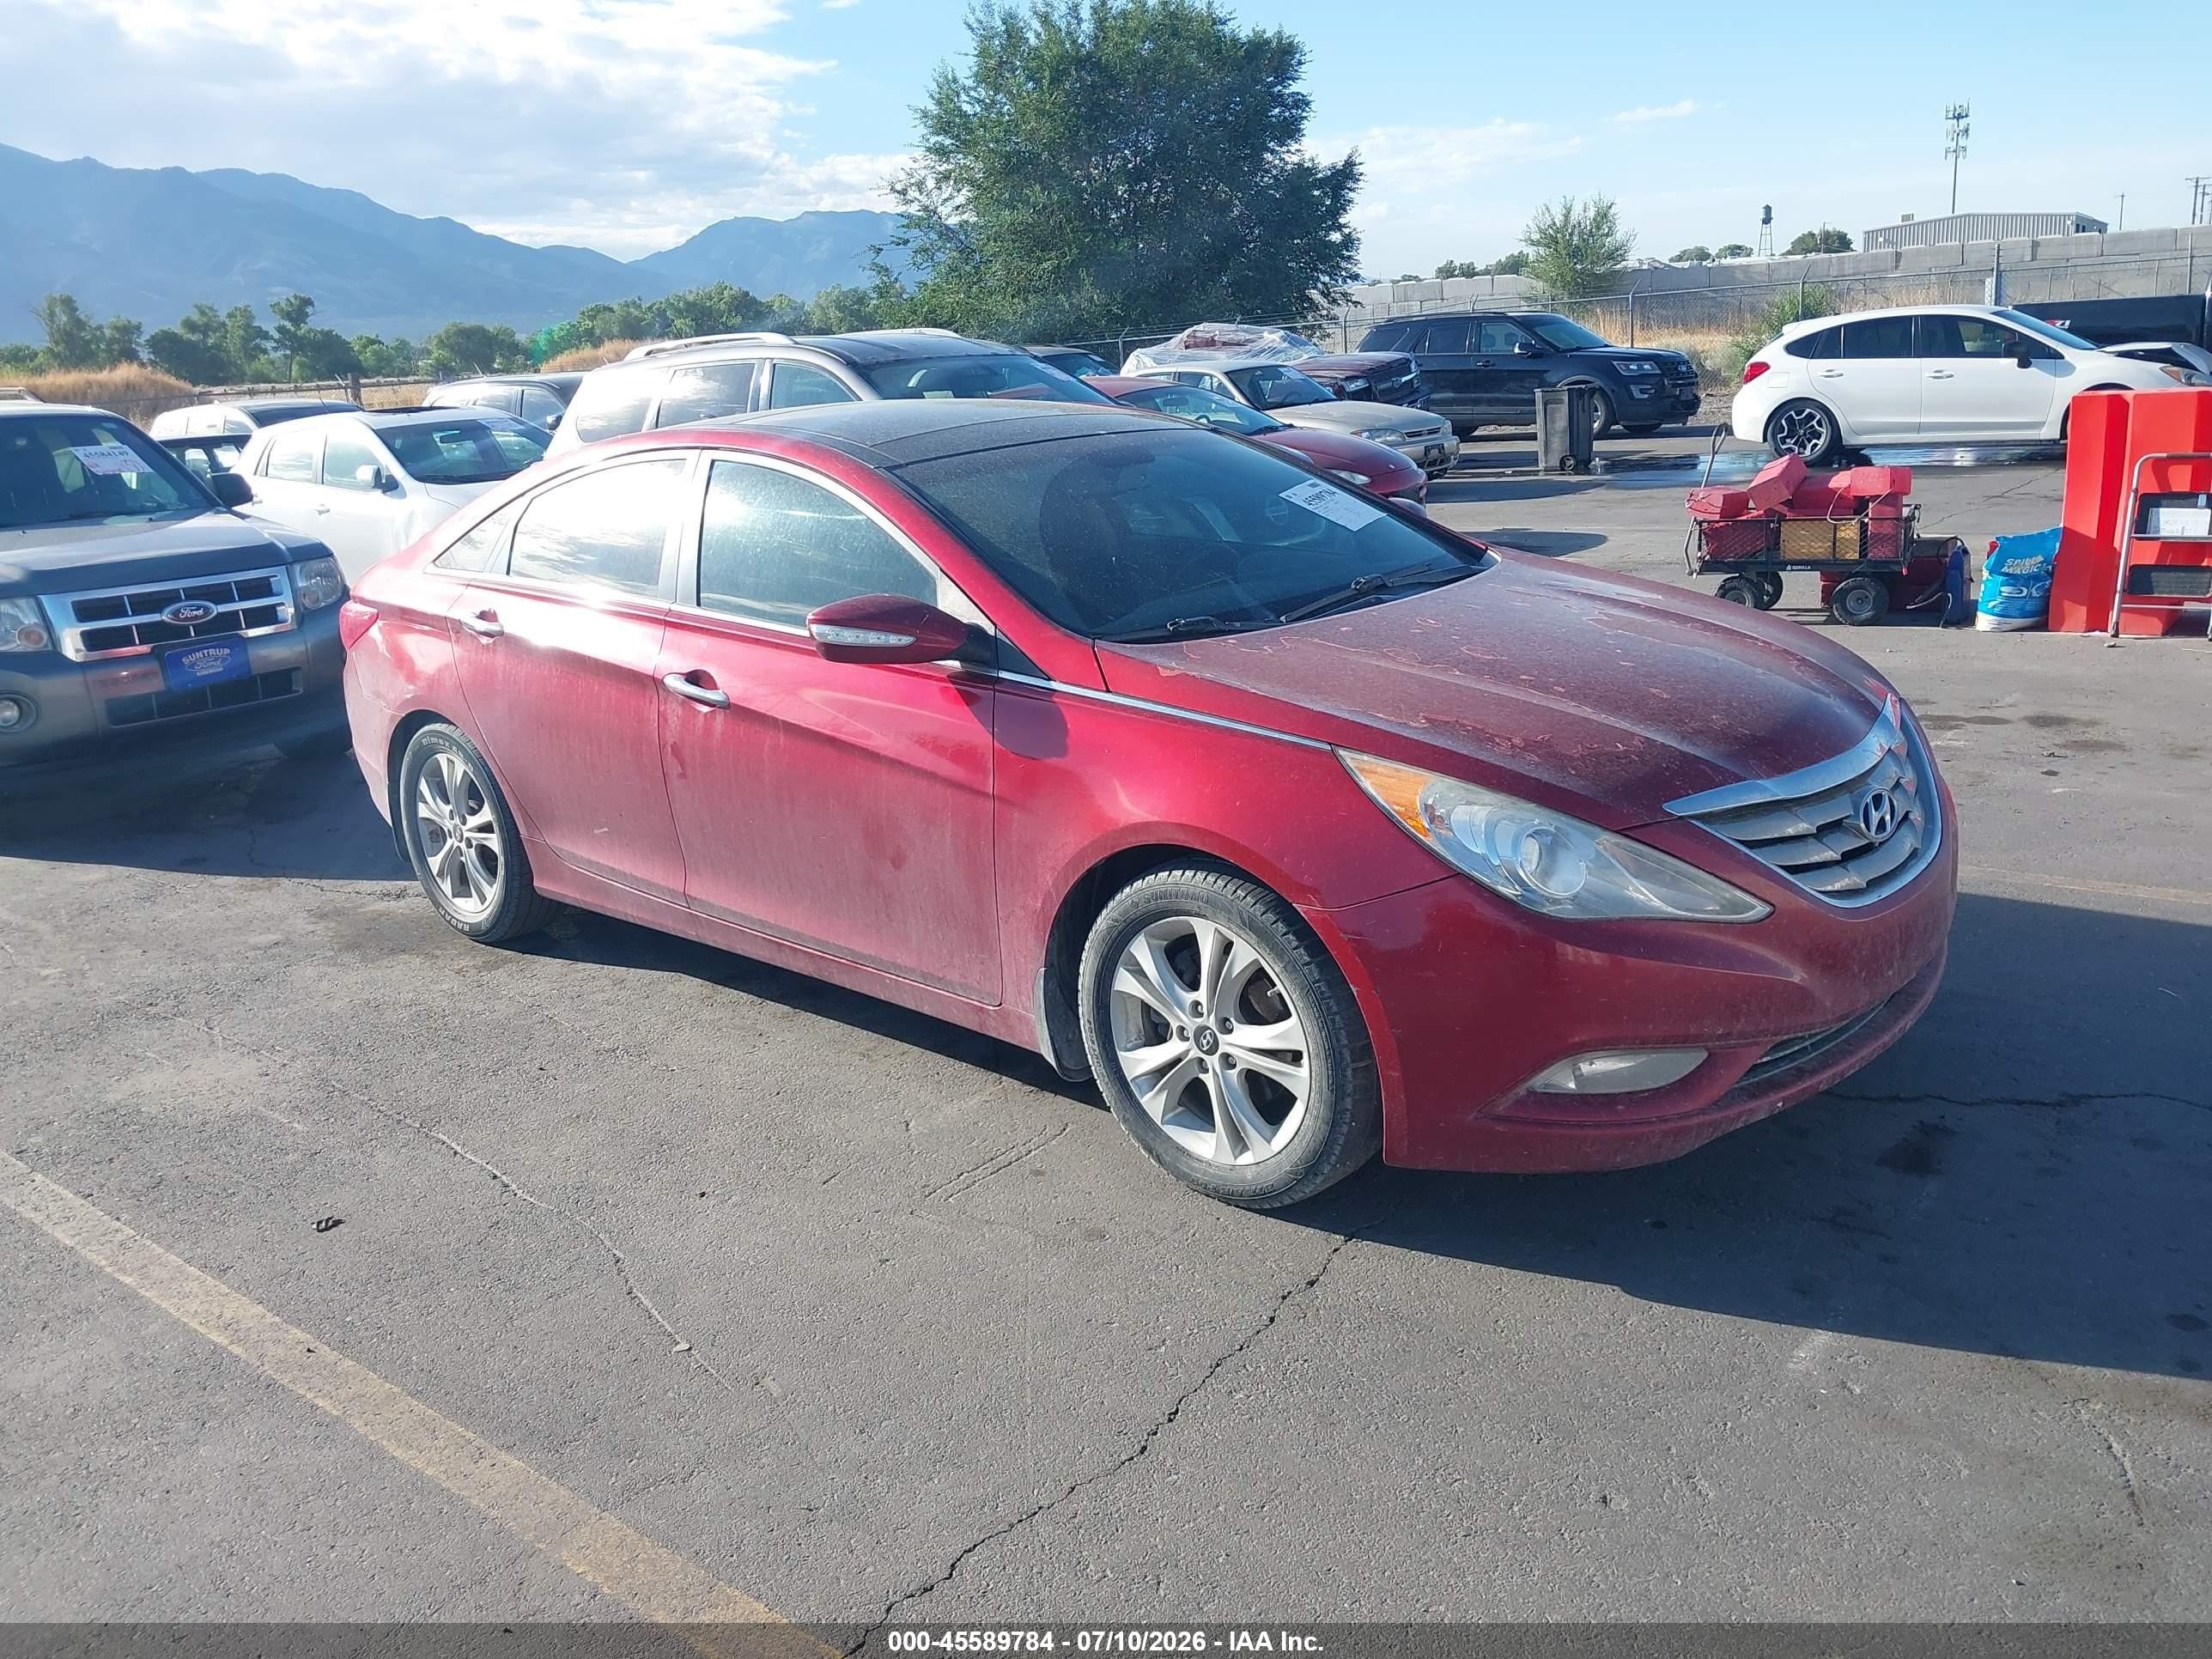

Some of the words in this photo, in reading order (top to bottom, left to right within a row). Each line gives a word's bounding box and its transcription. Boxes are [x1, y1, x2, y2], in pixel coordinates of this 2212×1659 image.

[2000, 563, 2041, 574] MAGIC
[179, 606, 204, 619] Ford
[181, 647, 231, 665] SUNTRUP
[194, 657, 222, 670] Ford
[1144, 887, 1210, 905] SUMITOMO
[438, 906, 471, 932] RADAR
